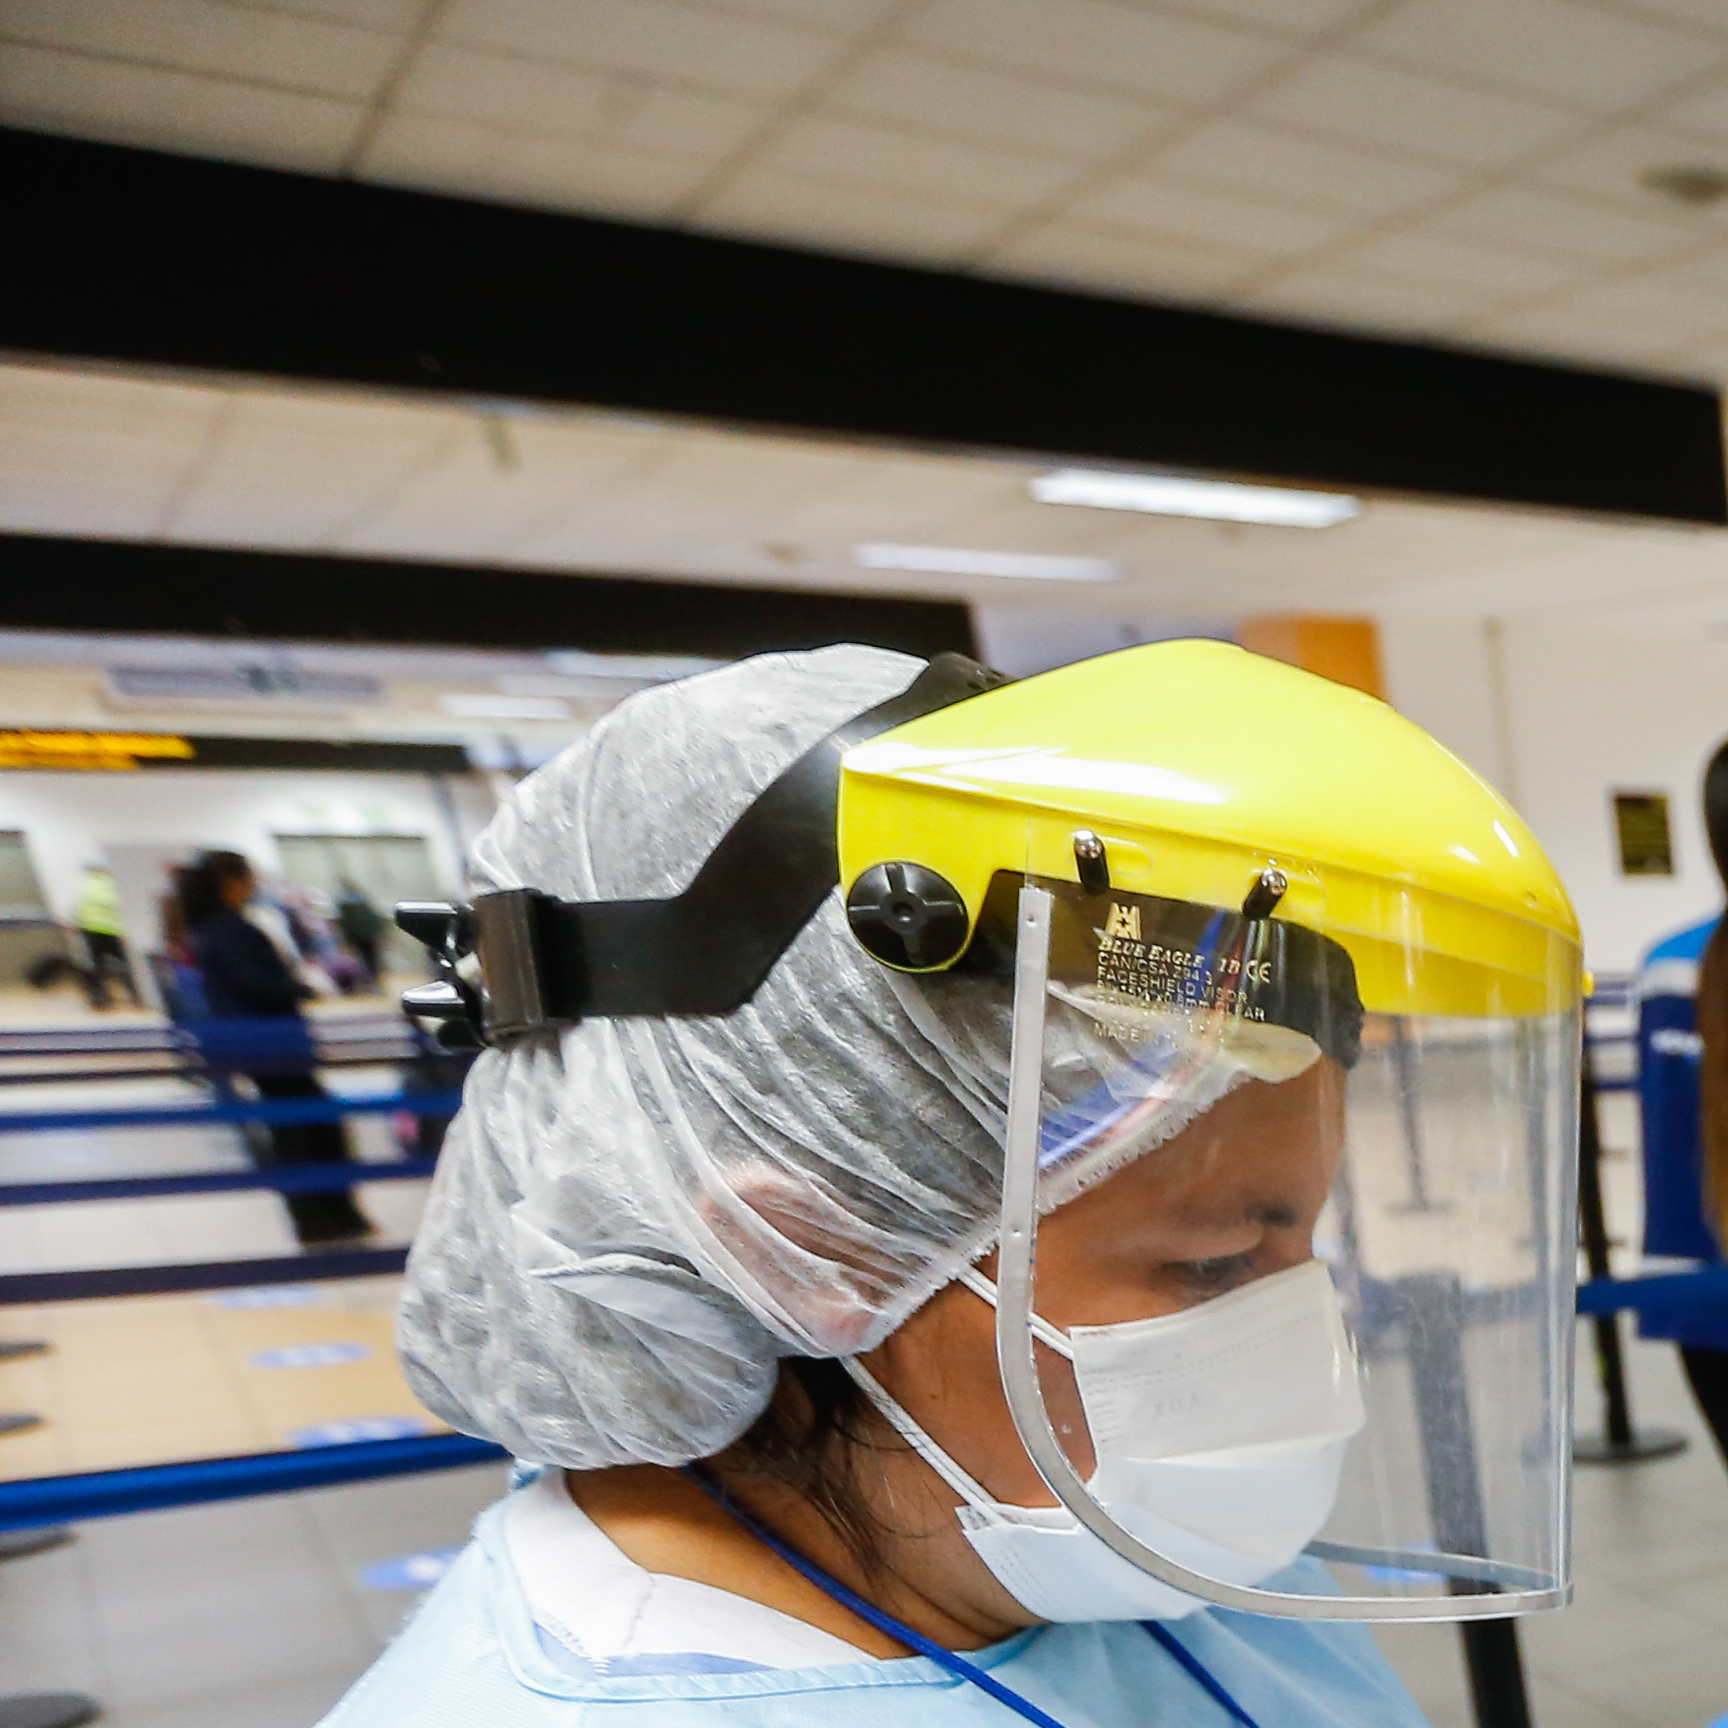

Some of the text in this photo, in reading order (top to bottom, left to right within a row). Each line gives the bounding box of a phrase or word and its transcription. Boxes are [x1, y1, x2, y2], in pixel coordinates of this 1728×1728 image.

[1098, 937, 1146, 958] BLUE
[1149, 945, 1205, 968] EAGLE
[1097, 966, 1248, 1004] FACESHIELD VISOR
